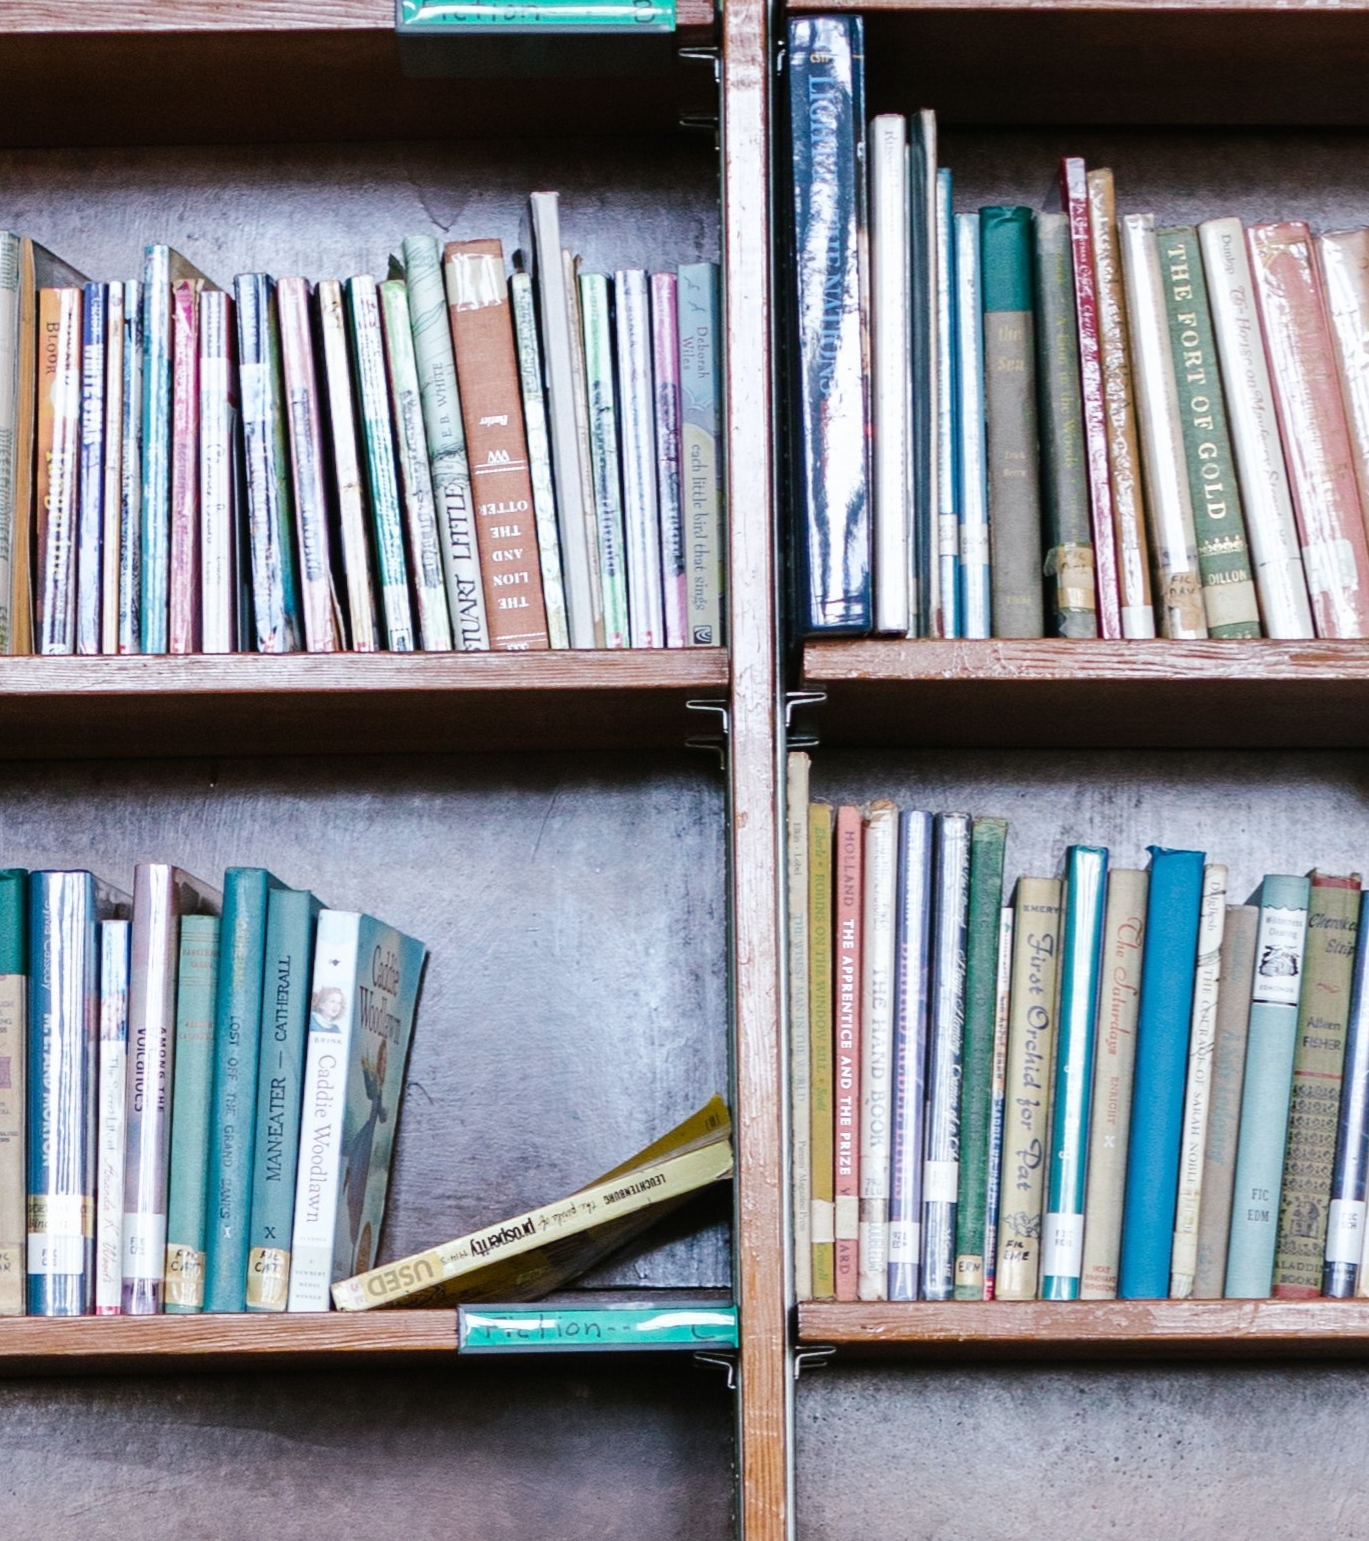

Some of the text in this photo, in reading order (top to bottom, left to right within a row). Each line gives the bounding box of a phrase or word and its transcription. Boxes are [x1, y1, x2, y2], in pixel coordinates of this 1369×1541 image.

[1166, 244, 1228, 522] THE FORT OF GOLD
[690, 444, 707, 611] each little bird that sings
[839, 919, 854, 1175] THE APPRENTICE AND THE PRIZE
[1015, 932, 1056, 1192] First Orchid for Pat
[305, 1054, 338, 1224] Caddie Woodlawn
[603, 1173, 666, 1205] LEUCHTENBURG
[367, 1258, 435, 1297] USED
[469, 1216, 536, 1258] prosperity
